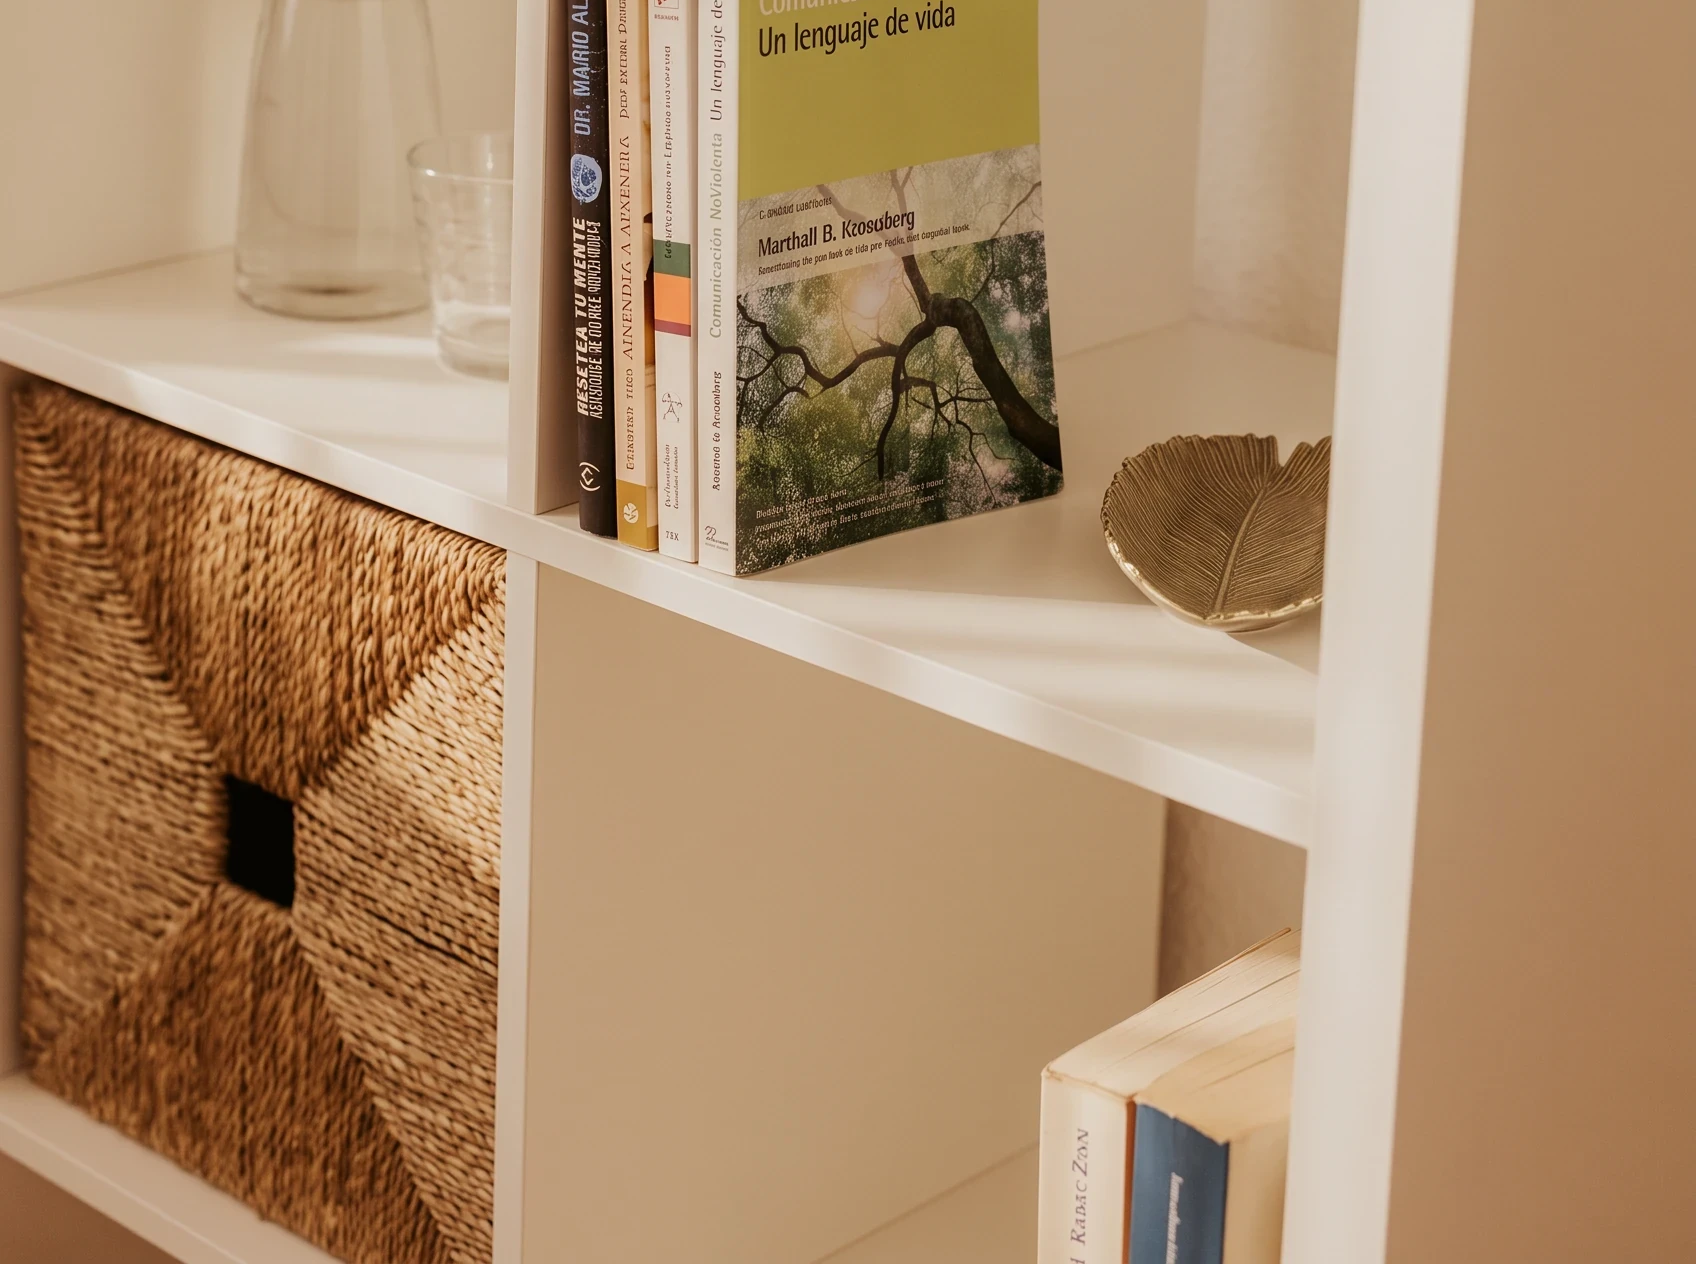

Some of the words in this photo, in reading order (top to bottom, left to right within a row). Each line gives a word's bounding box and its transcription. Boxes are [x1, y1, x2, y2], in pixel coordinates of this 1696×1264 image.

[710, 25, 726, 92] lenguaje
[758, 26, 786, 57] Un
[794, 11, 879, 55] lenguaje
[885, 7, 909, 36] de
[915, 0, 955, 31] vida
[710, 99, 723, 122] Un
[709, 132, 723, 221] NoViolenta
[572, 216, 587, 289] MENTE
[758, 224, 818, 258] Marthall
[822, 223, 837, 243] B.
[574, 292, 587, 319] TU
[709, 227, 723, 339] Comunicación
